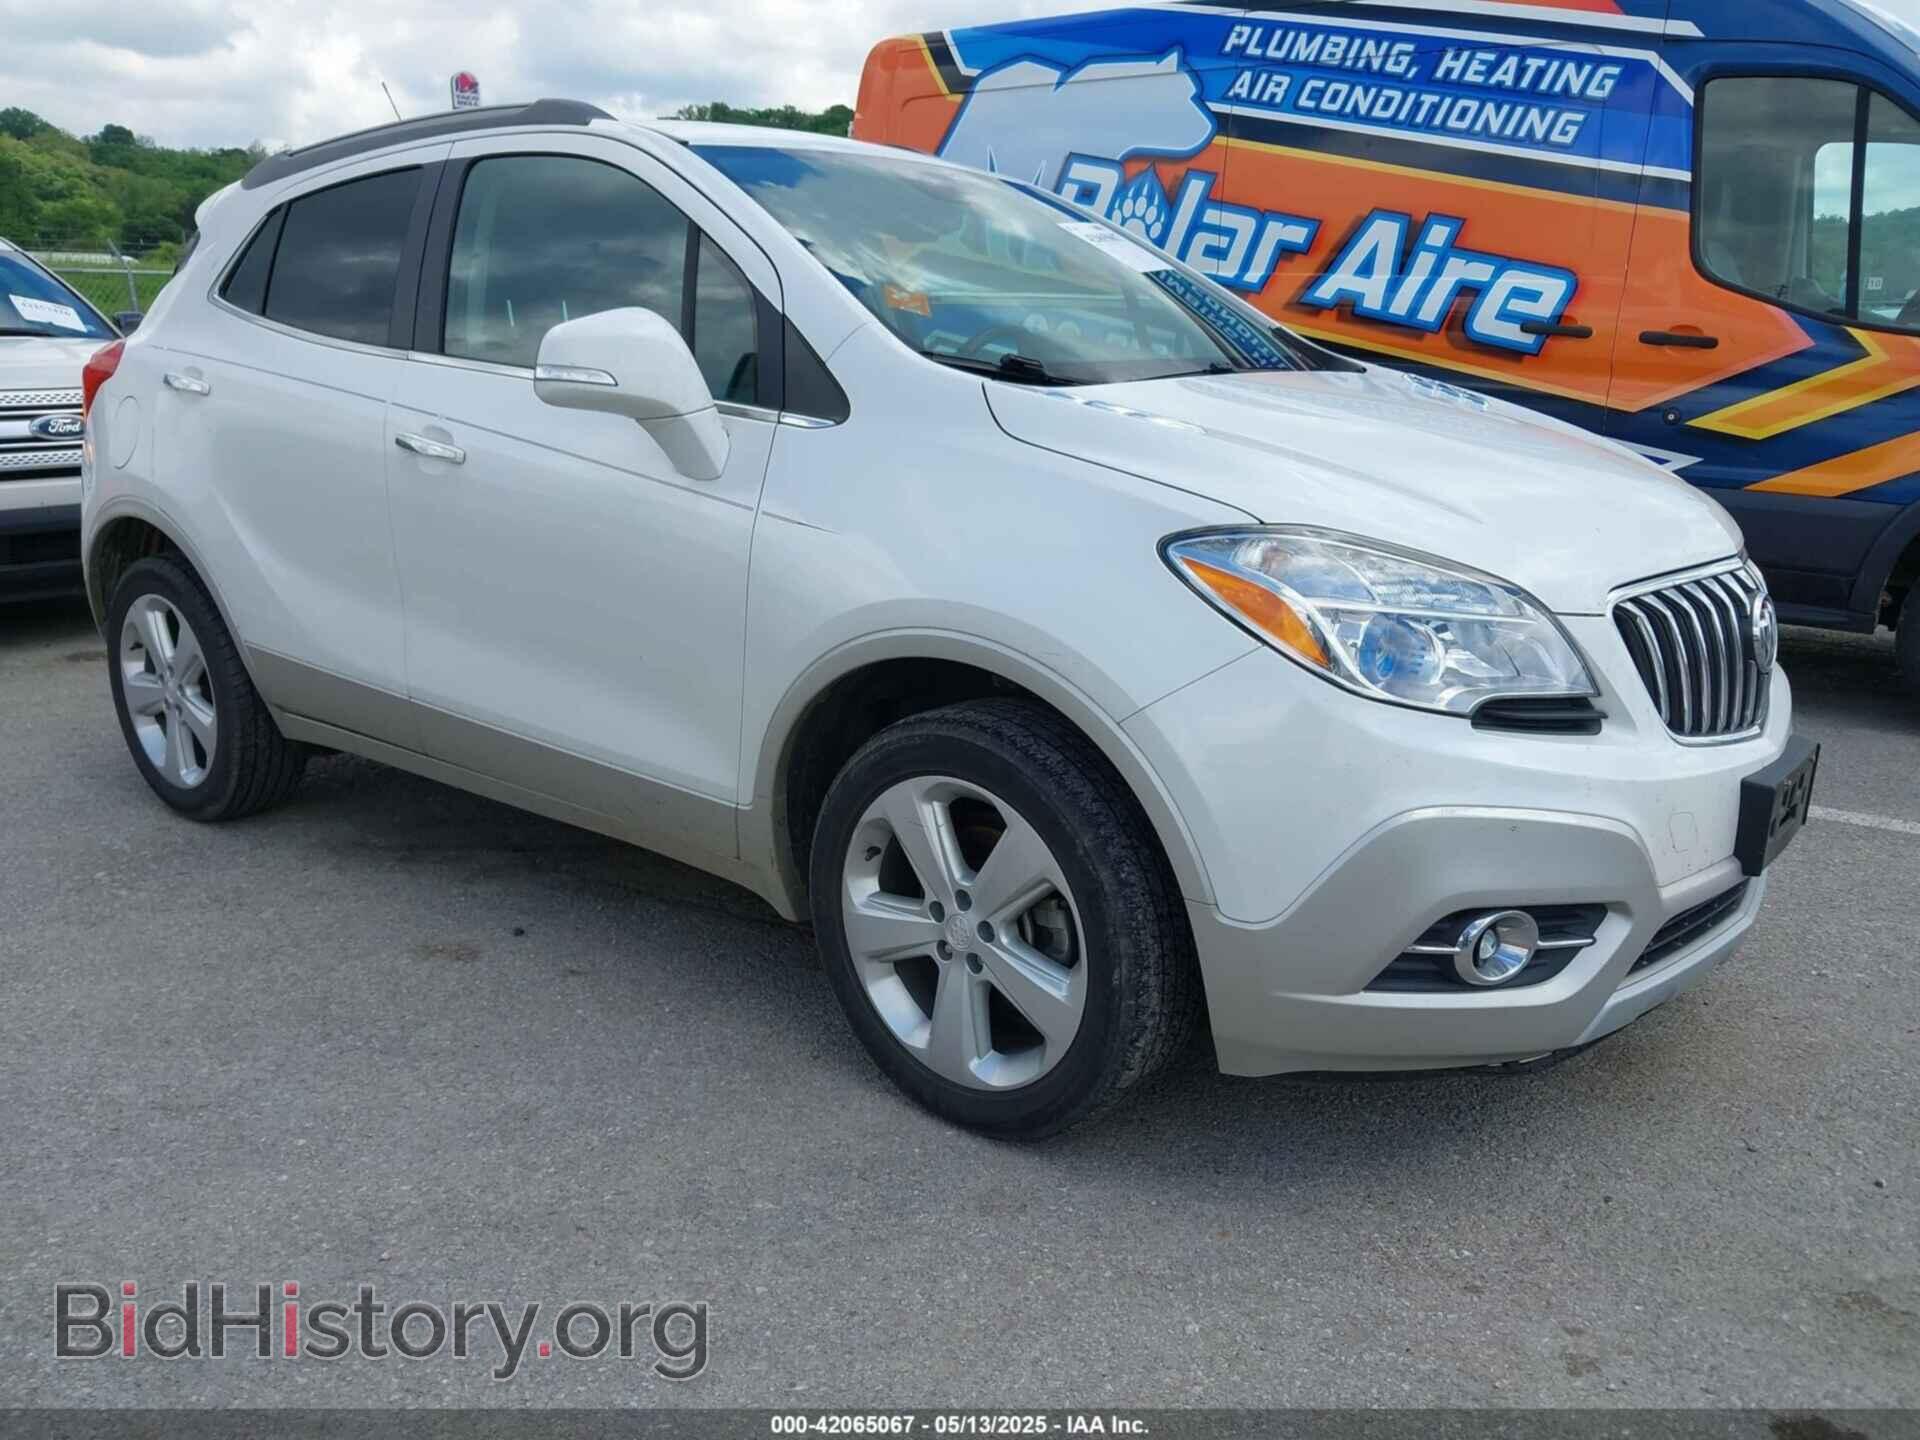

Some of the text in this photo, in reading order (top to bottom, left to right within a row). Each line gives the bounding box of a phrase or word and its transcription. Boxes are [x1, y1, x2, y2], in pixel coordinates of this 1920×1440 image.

[1223, 25, 1622, 98] PLUMBING, HEATING
[1227, 70, 1586, 145] AIR CONDITIONING
[1312, 217, 1569, 346] Aire
[48, 418, 81, 433] Ford
